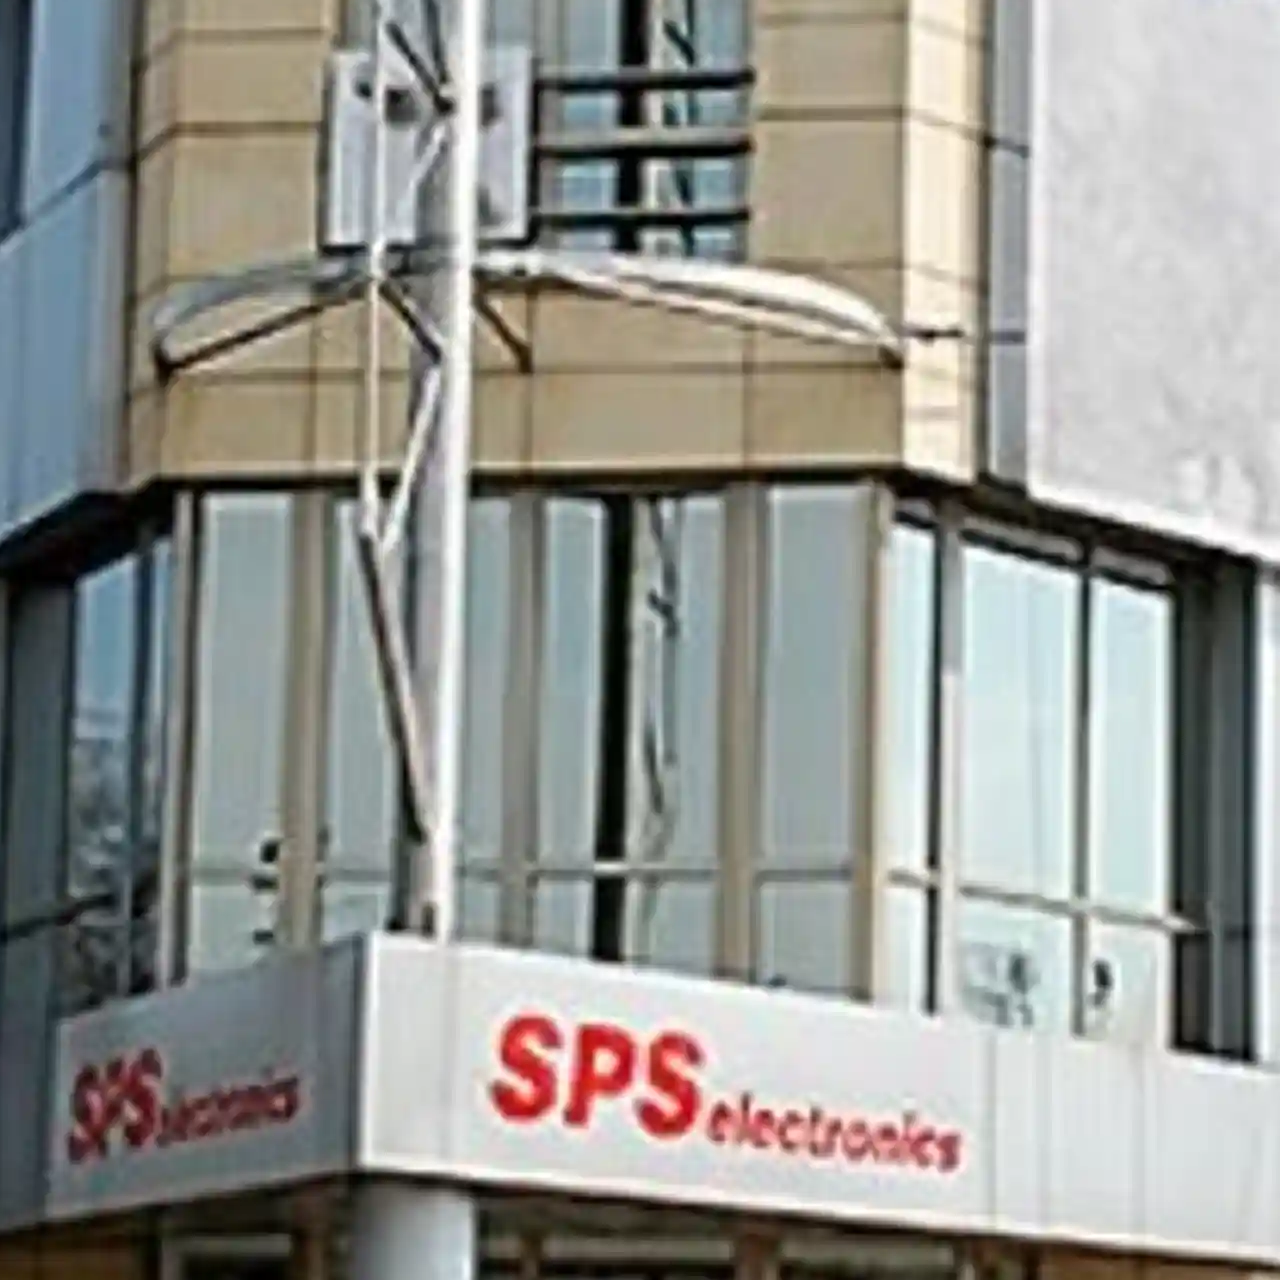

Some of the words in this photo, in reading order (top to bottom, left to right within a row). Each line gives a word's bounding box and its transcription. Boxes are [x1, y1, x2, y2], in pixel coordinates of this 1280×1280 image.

[66, 1045, 164, 1167] SPS
[486, 1013, 710, 1140] SPS
[705, 1089, 966, 1175] electronics
